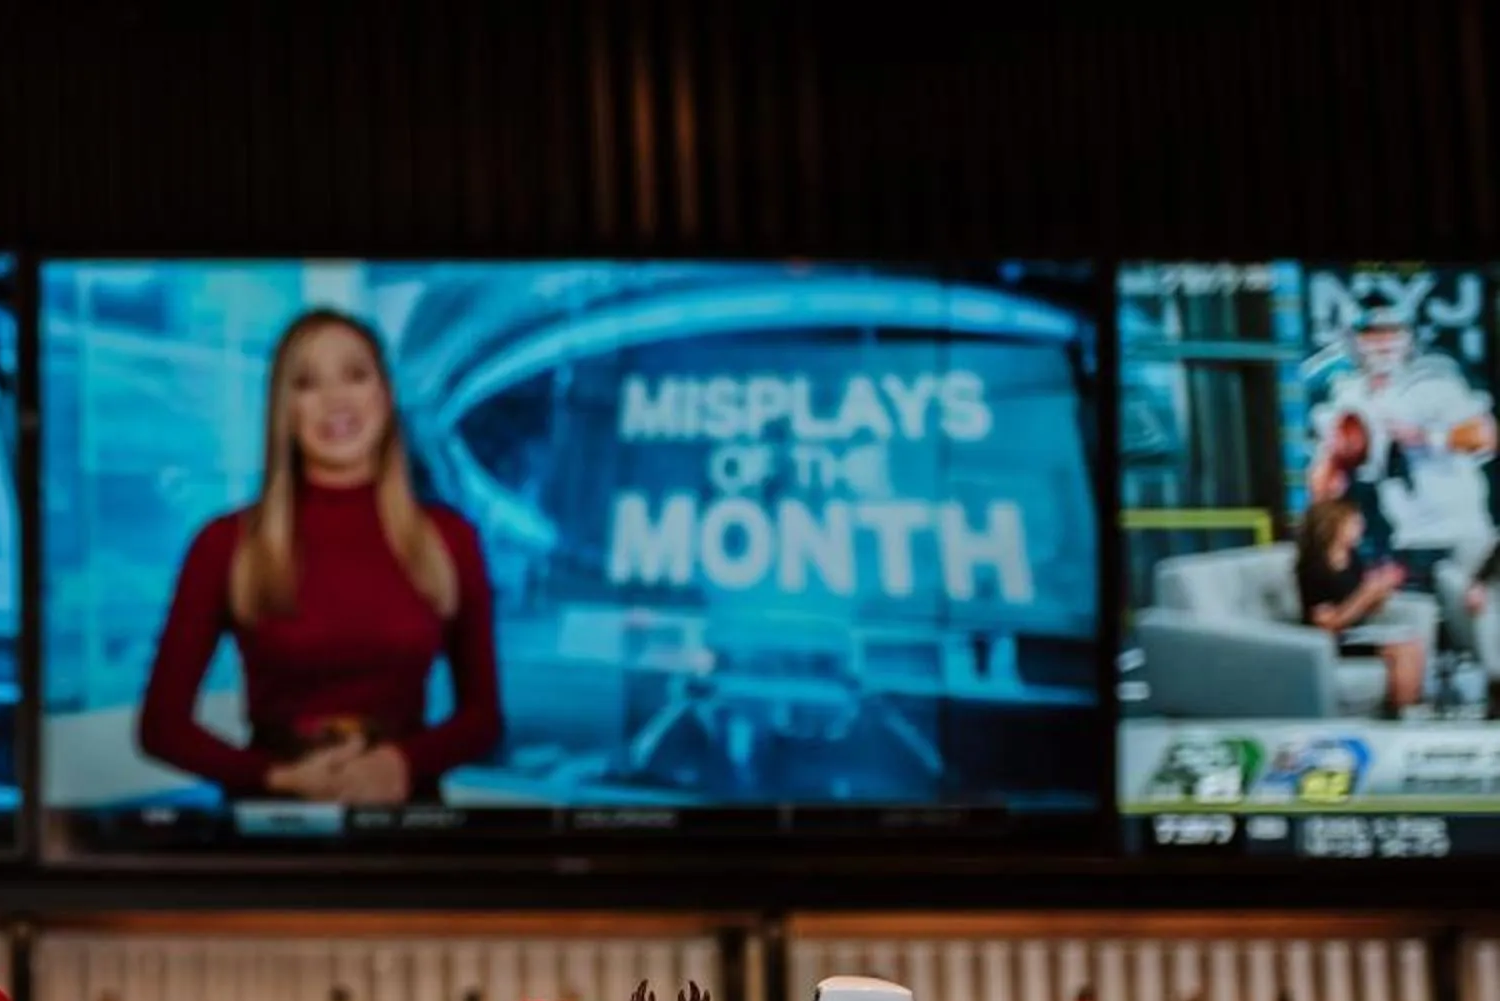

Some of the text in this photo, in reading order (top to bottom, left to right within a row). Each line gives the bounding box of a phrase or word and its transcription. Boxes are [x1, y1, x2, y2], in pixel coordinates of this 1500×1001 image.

[620, 370, 993, 441] MISPLAYS
[710, 443, 776, 492] OF
[609, 493, 1035, 602] MONTH
